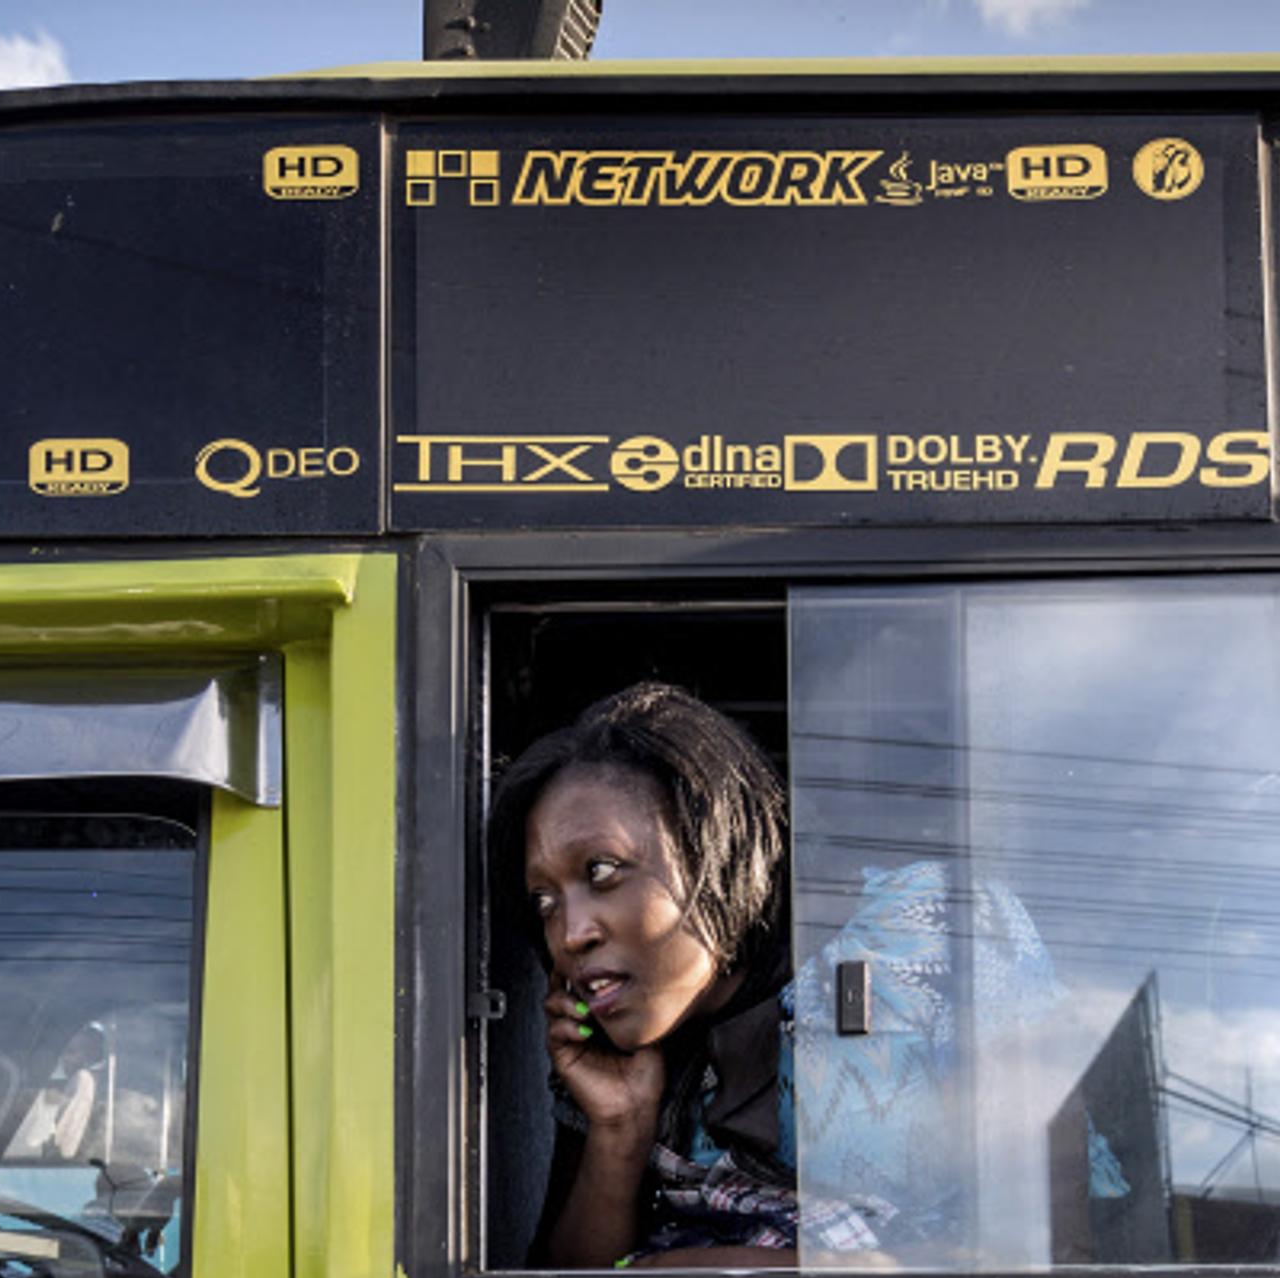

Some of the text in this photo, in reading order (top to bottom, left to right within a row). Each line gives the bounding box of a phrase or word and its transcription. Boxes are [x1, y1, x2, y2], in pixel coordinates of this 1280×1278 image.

[278, 156, 344, 179] HD
[511, 150, 884, 206] NETWORK
[1022, 155, 1092, 180] HD
[45, 449, 113, 473] HD
[195, 438, 360, 498] QDEO
[396, 435, 609, 484] THX
[683, 435, 780, 472] dlna
[1035, 431, 1271, 489] RDS
[683, 474, 783, 489] CERTIFIED
[886, 469, 1019, 491] TRUEHD
